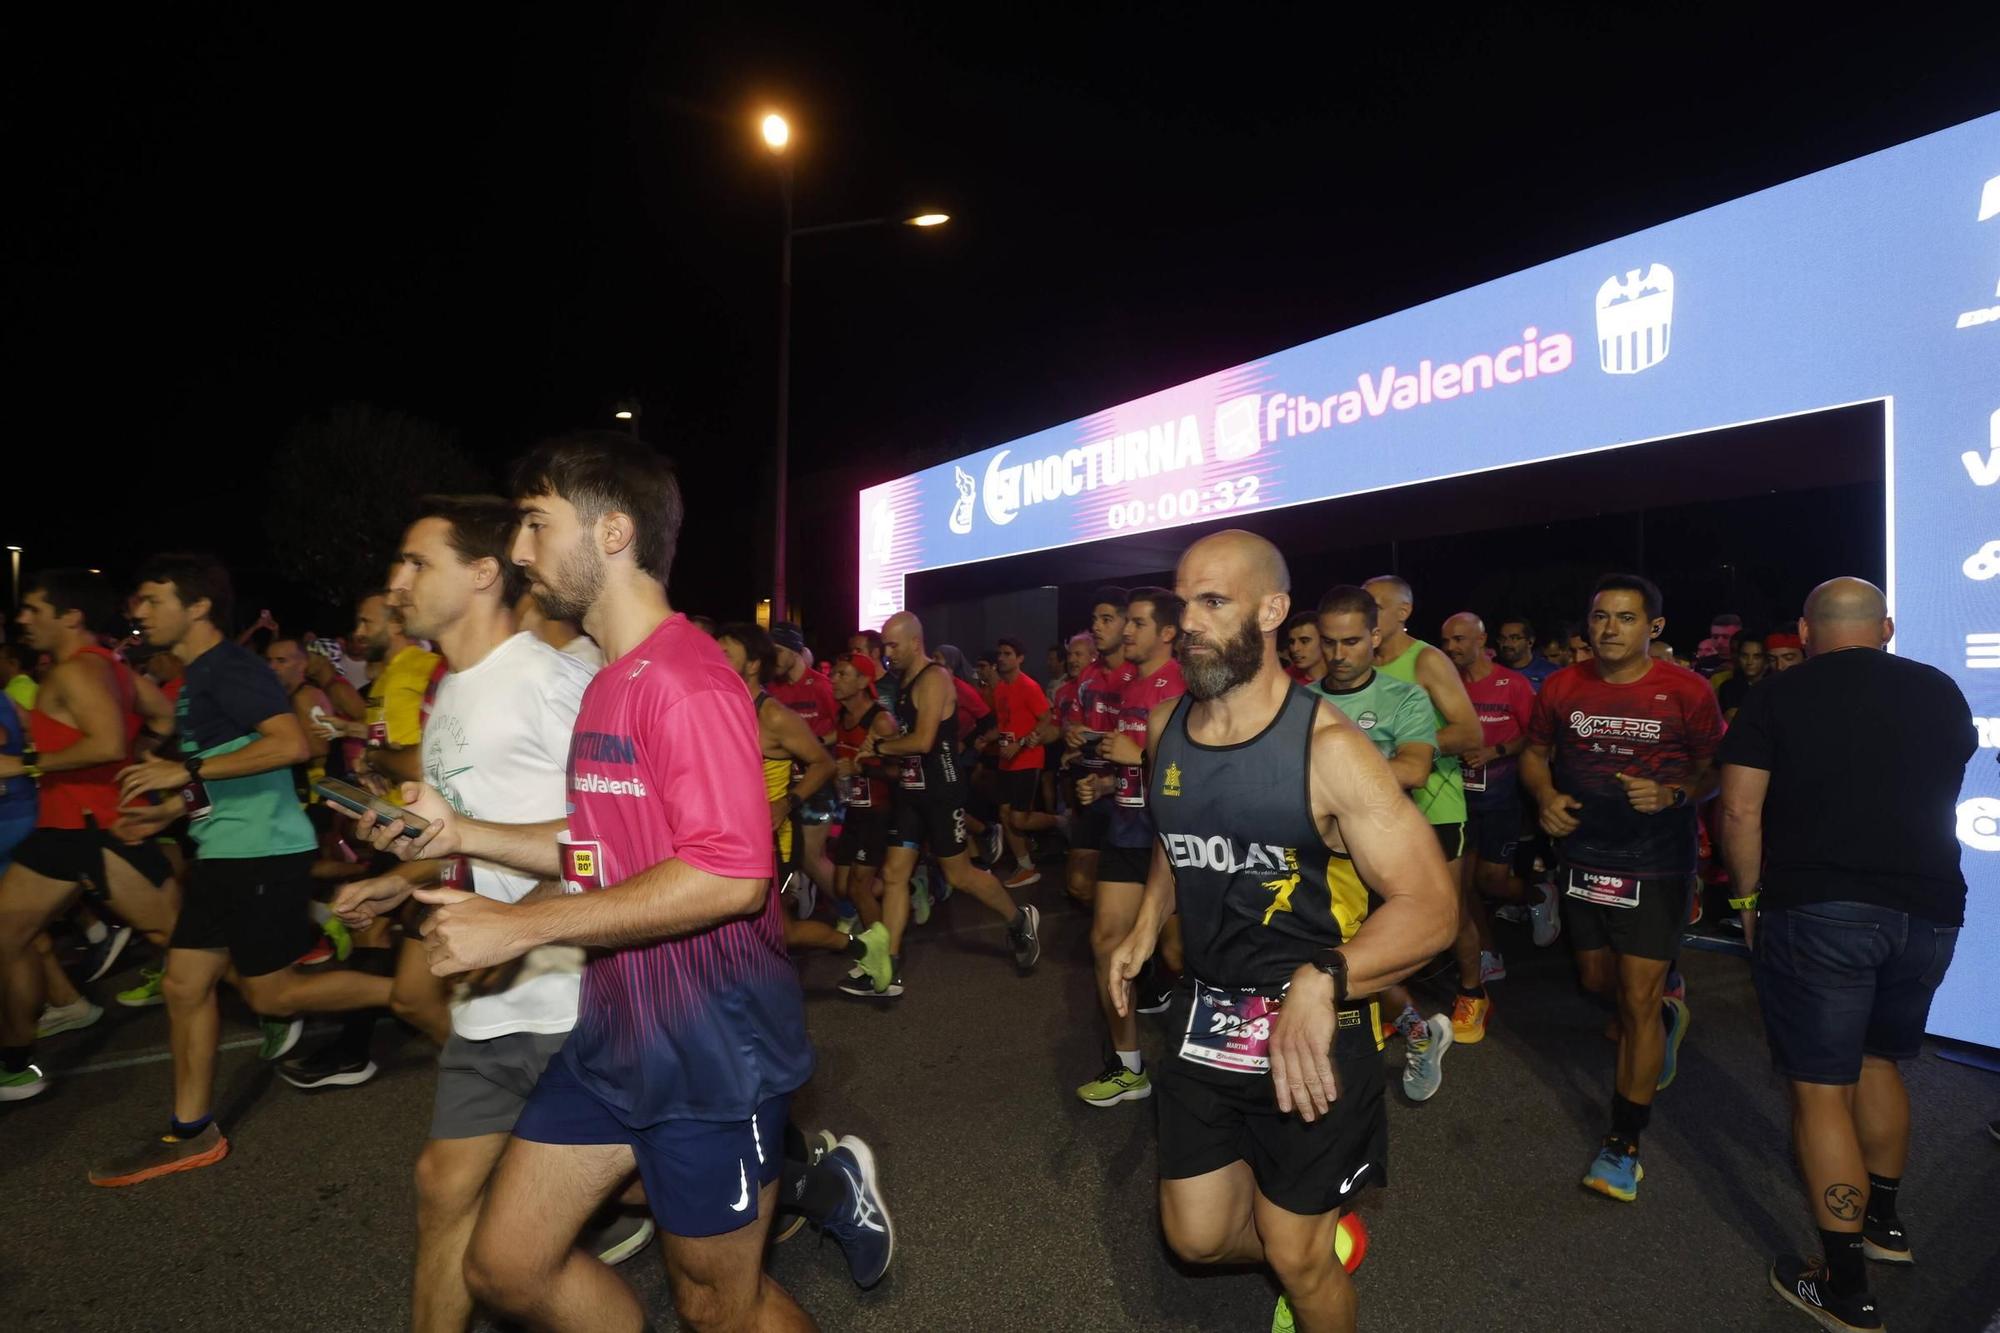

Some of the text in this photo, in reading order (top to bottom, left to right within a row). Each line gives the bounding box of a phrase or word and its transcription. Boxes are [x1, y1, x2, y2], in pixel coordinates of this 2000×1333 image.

[1266, 326, 1574, 442] fibraValencia
[1023, 414, 1204, 506] NOCTURNA
[1107, 475, 1260, 530] 00:00:32
[1593, 727, 1661, 740] MARATON
[576, 853, 591, 862] SUB
[1226, 1041, 1249, 1051] MARTIN
